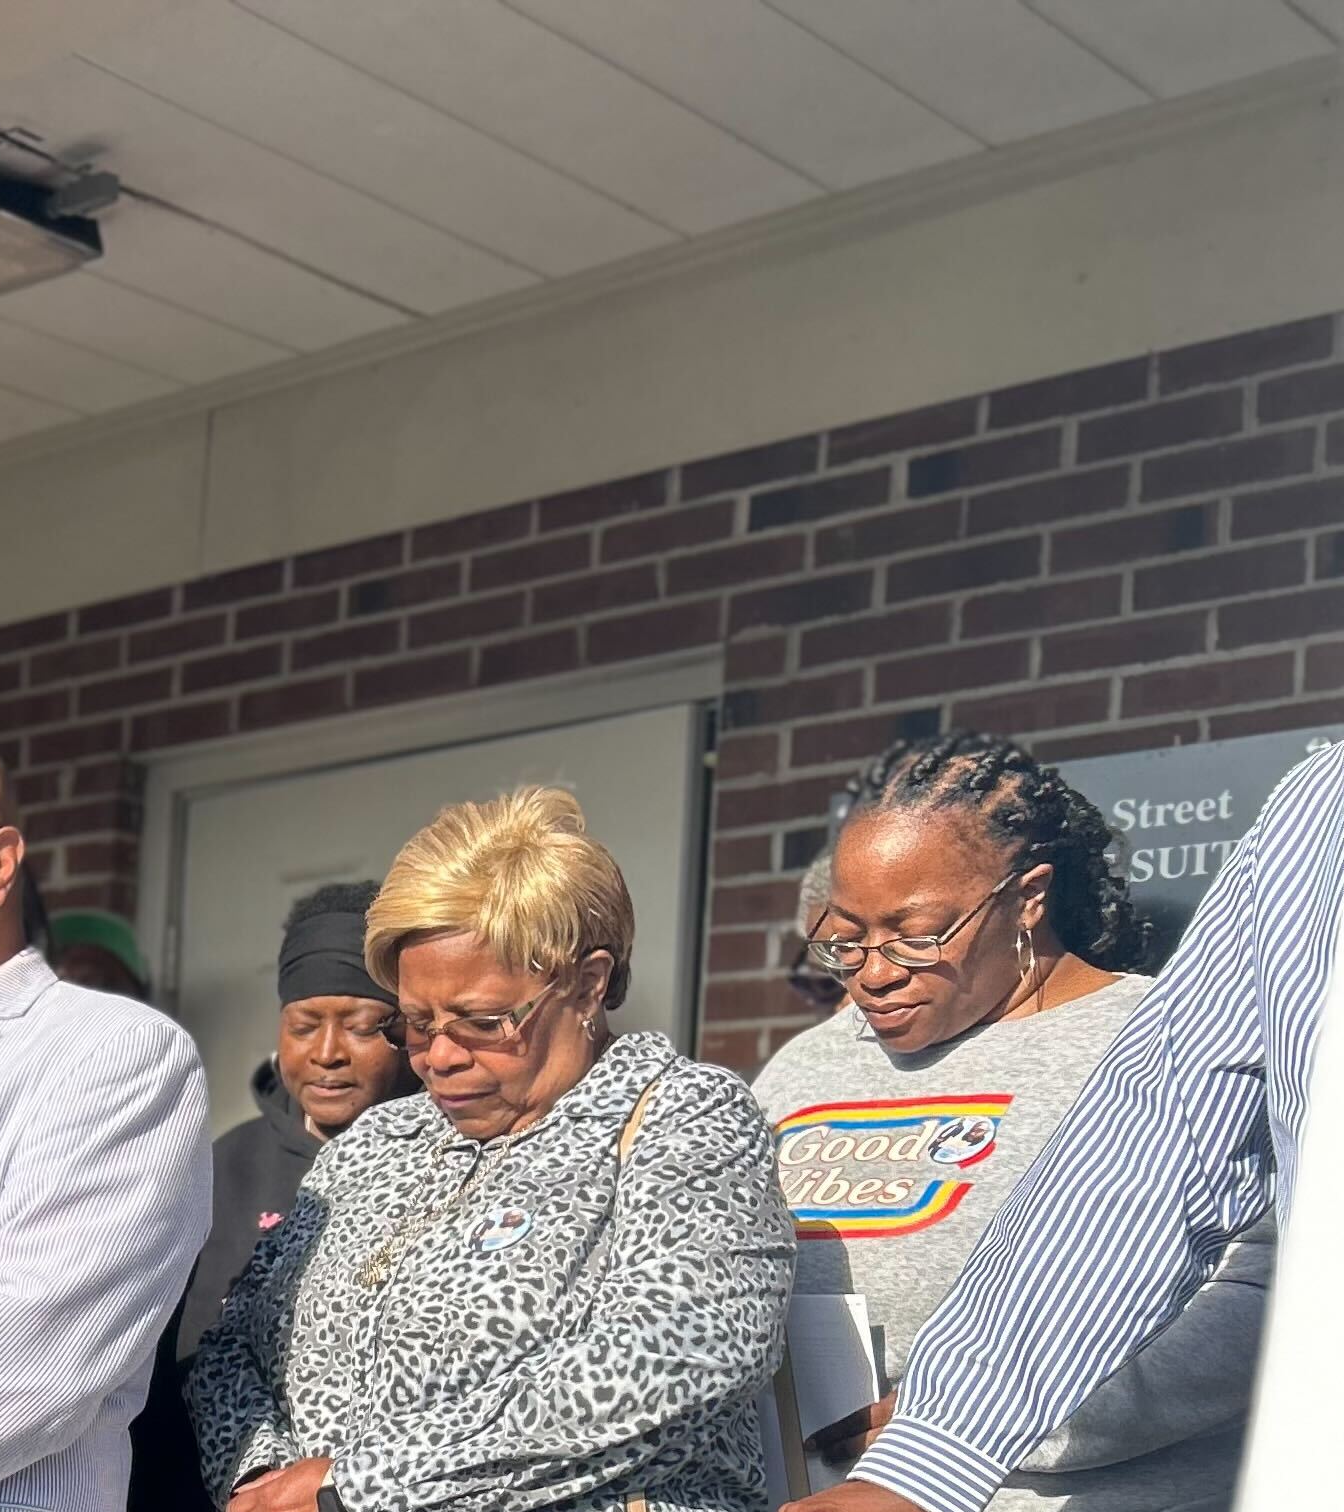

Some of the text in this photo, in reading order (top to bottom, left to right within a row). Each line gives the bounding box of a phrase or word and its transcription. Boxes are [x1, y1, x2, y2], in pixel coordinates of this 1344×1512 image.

[1112, 789, 1234, 832] Street
[778, 1118, 941, 1165] Good
[777, 1166, 915, 1205] Vibes
